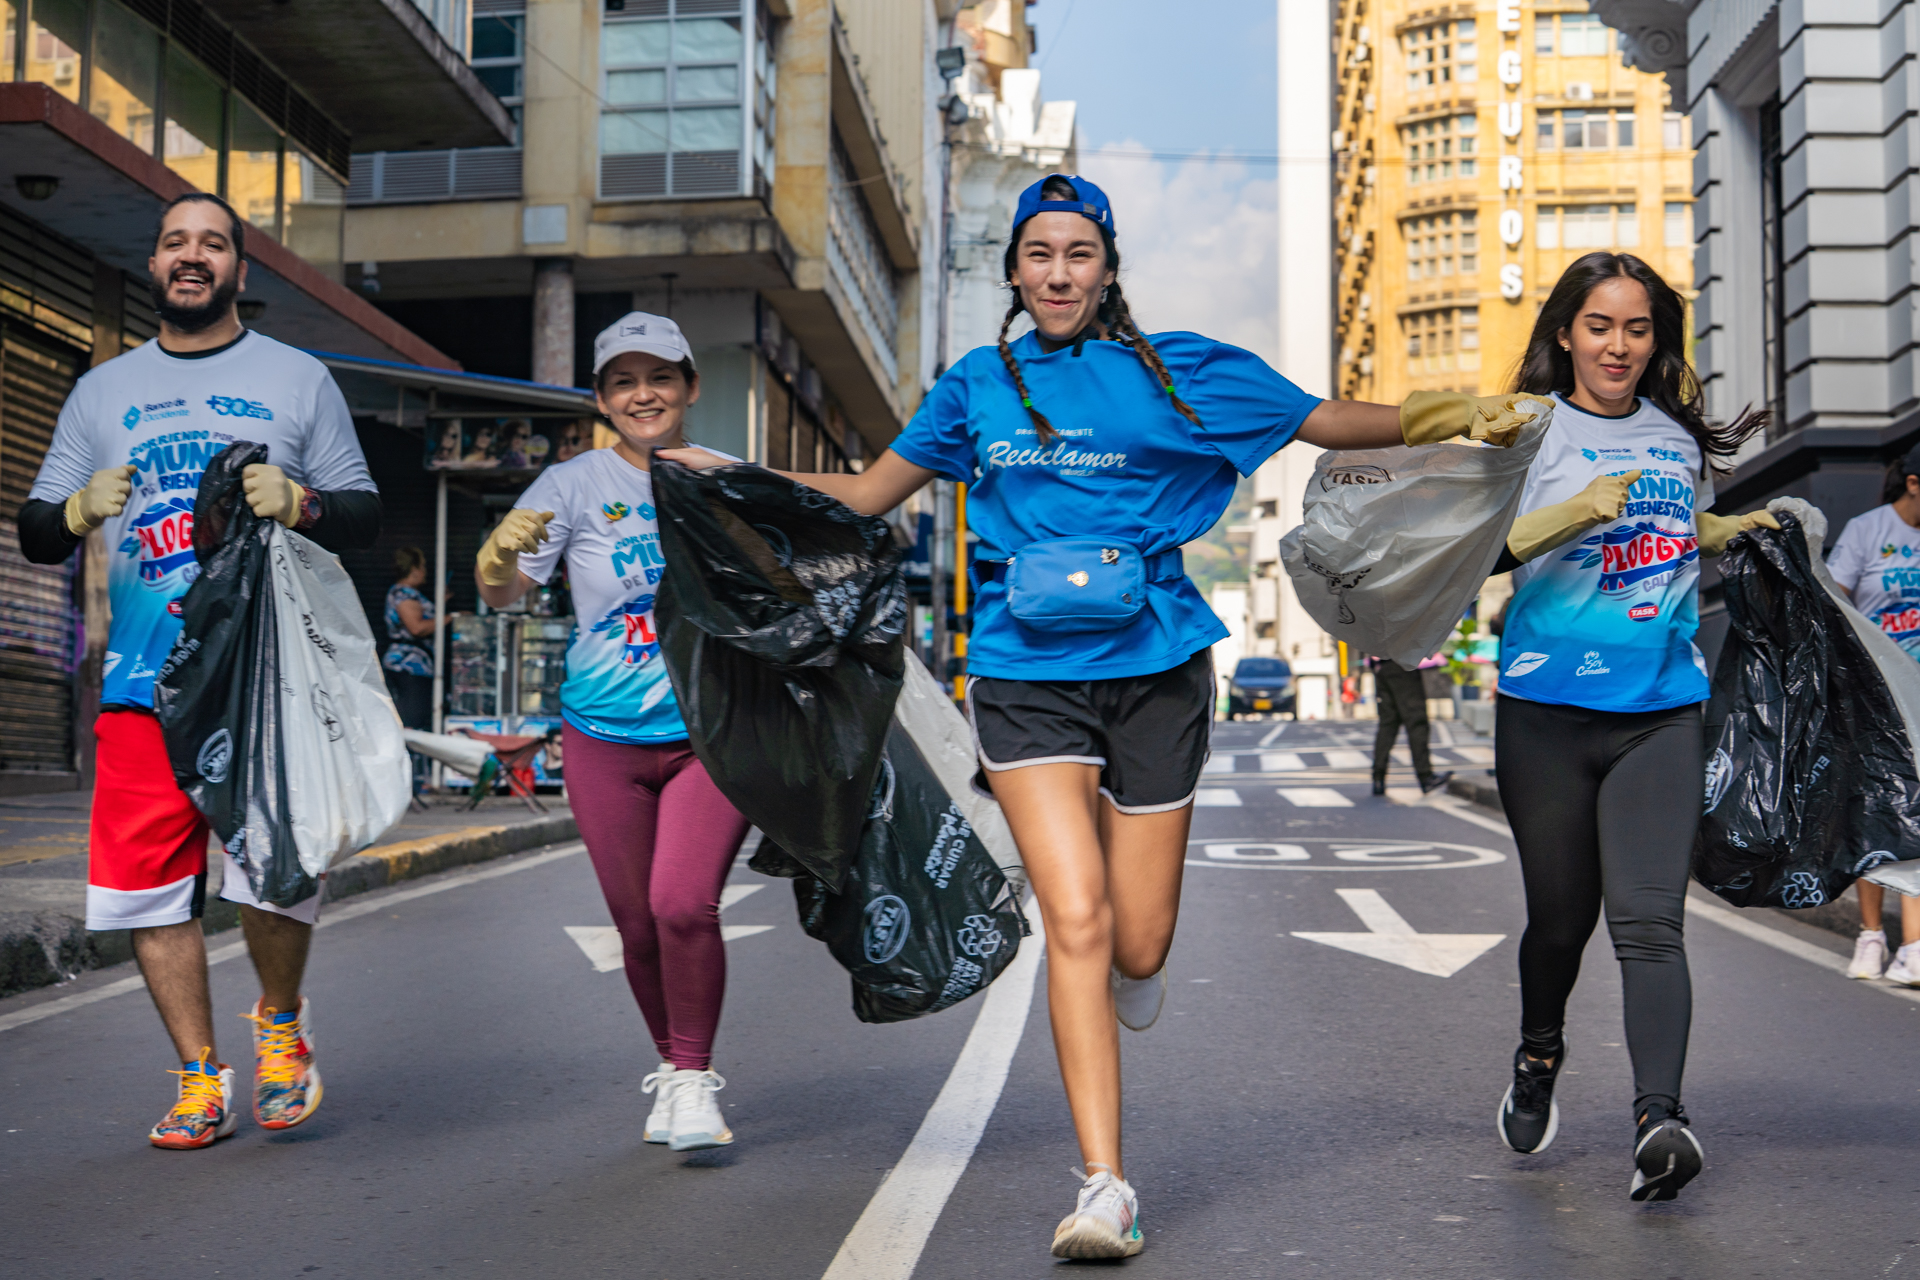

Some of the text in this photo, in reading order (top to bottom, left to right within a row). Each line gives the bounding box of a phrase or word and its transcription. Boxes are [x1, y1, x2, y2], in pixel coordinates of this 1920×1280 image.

[129, 430, 210, 457] CORRIENDO
[986, 440, 1127, 470] Reciclamor
[127, 442, 228, 487] MUN
[1627, 476, 1694, 509] UNDO
[1626, 501, 1691, 525] BIENESTAR
[622, 575, 642, 590] DE
[1631, 608, 1656, 616] TASK
[935, 839, 966, 889] CUIDAR
